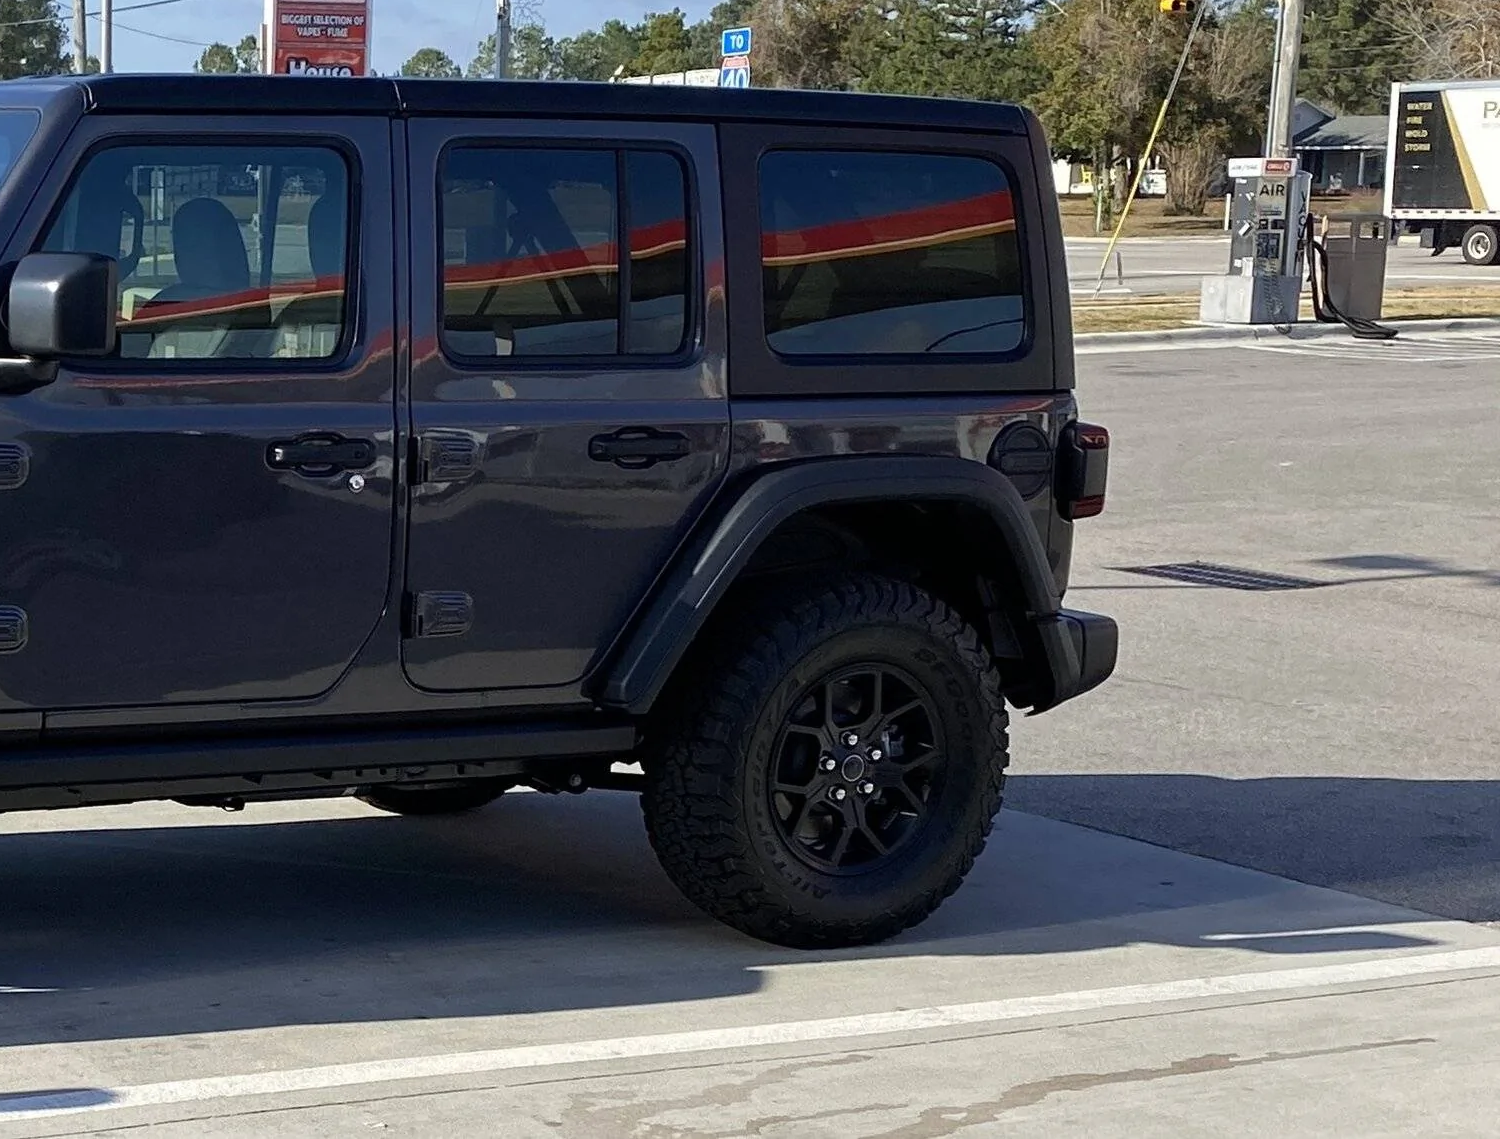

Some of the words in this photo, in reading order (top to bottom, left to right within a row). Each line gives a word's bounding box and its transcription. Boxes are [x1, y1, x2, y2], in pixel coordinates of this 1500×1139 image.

[281, 14, 312, 24] BIGGEST
[313, 15, 353, 25] SELECTION
[353, 16, 364, 26] OF
[730, 34, 744, 49] TO
[724, 68, 747, 88] 40
[1260, 184, 1285, 196] AIR
